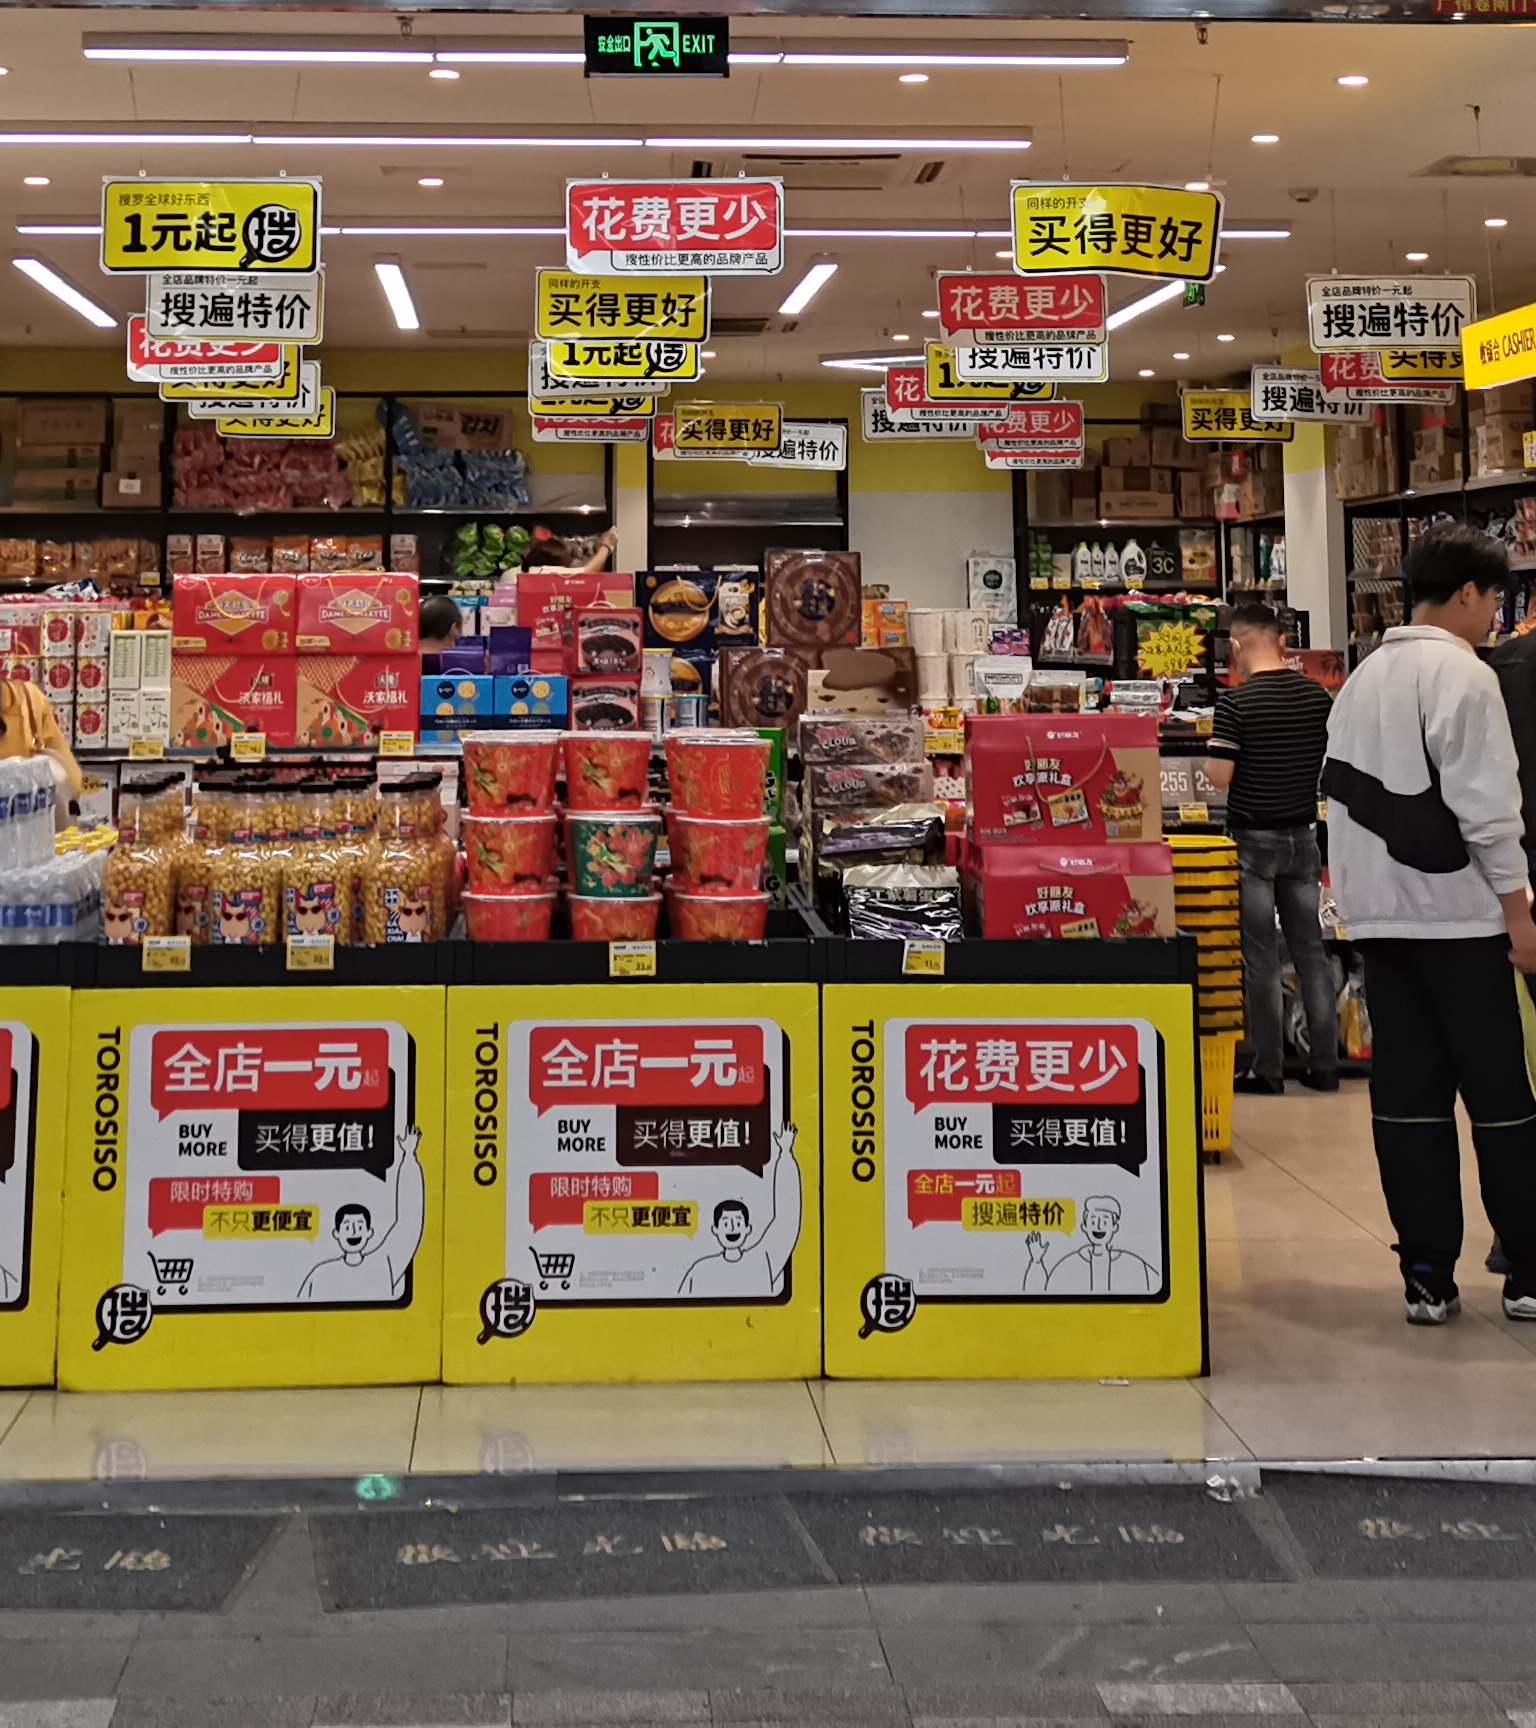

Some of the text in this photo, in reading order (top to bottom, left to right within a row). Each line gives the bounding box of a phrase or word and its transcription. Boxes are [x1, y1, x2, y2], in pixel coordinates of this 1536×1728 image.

[598, 35, 631, 53] 安全出口
[683, 34, 715, 53] EXIT
[582, 197, 767, 242] 花费更少
[122, 212, 236, 253] 1元起
[1028, 214, 1202, 262] 买得更好
[625, 253, 768, 265] 搜性价比更高的品牌产品
[160, 293, 311, 329] 搜遍特价
[549, 293, 696, 328] 买得更好
[950, 285, 1093, 322] 花费更少
[1323, 303, 1464, 339] 搜遍特价
[1502, 328, 1536, 357] CASHIER
[682, 418, 774, 441] 买得更好
[1160, 772, 1187, 791] 255
[920, 1039, 1128, 1092] 花费更少
[93, 1027, 121, 1192] TOROSISO
[475, 1022, 498, 1187] TOROSISO
[852, 1020, 875, 1183] TOROSISO
[179, 1124, 213, 1139] BUY
[558, 1119, 591, 1134] BUY
[935, 1117, 968, 1131] BUY
[179, 1142, 227, 1157] MORE
[557, 1137, 606, 1152] MORE
[934, 1134, 983, 1149] MORE
[170, 1182, 253, 1202] 限时特购
[551, 1177, 632, 1197] 限时特购
[914, 1174, 1015, 1194] 全店一元起
[210, 1210, 312, 1232] 不只更便宜
[591, 1205, 691, 1228] 不只更便宜
[972, 1202, 1064, 1226] 搜遍特价
